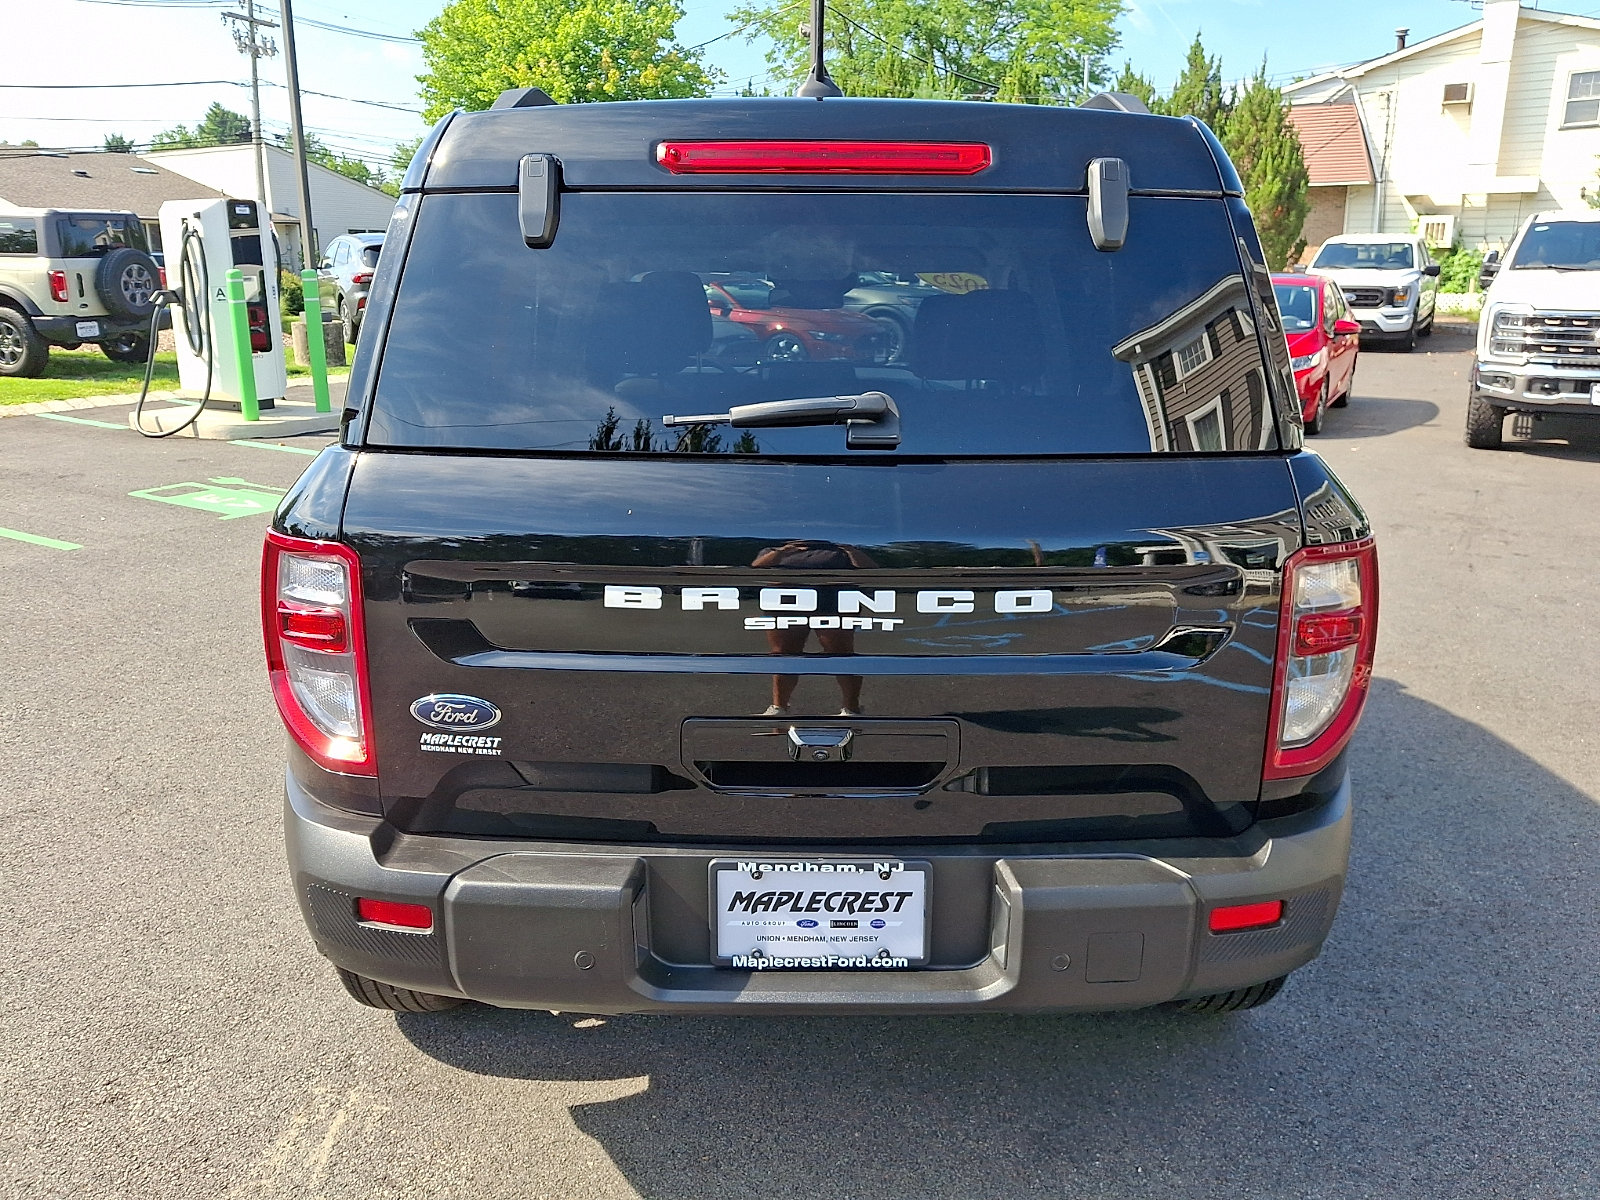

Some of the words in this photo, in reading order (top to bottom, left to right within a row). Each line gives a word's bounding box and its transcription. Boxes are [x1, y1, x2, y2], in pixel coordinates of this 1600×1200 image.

[216, 287, 226, 298] A
[604, 585, 1053, 614] BRONCO
[743, 615, 904, 632] SPORT
[420, 733, 502, 748] MAPLECREST
[420, 744, 456, 753] MENDHAM
[458, 746, 473, 754] NEW
[475, 747, 502, 756] JERSEY
[737, 861, 864, 874] Mendham,
[873, 862, 905, 874] NJ
[727, 891, 914, 915] MAPLECREST
[786, 935, 828, 943] MENDHAM,
[732, 955, 909, 970] MaplecrestFord.com
